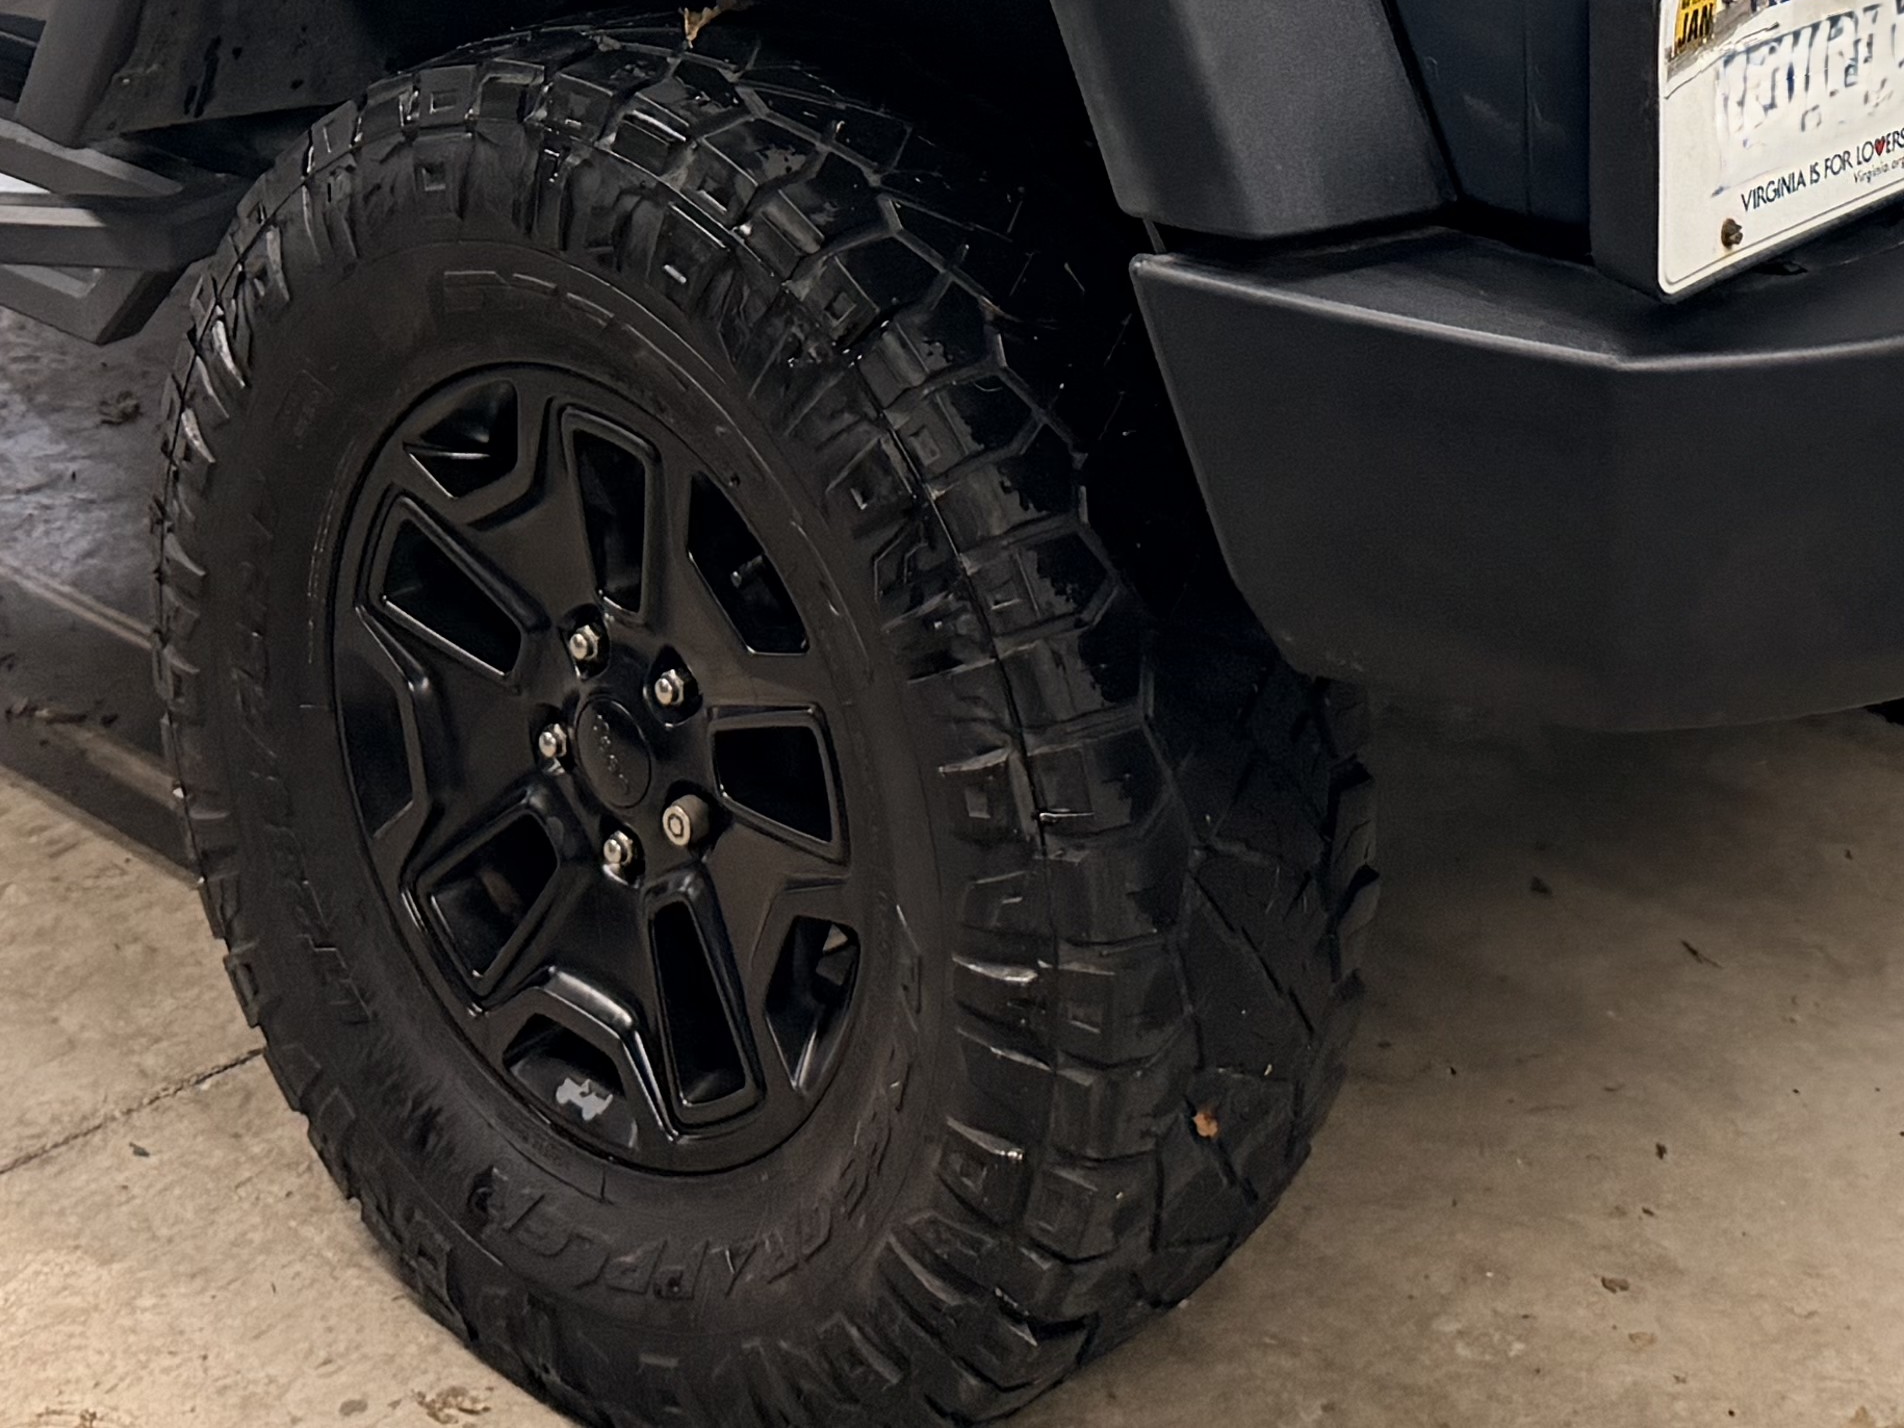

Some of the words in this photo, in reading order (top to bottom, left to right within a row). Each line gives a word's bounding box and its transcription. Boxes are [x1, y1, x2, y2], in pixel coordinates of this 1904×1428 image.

[1677, 3, 1715, 47] JAN
[1741, 169, 1807, 212] VIRGINIA
[1809, 162, 1821, 185] IS
[1824, 150, 1853, 179] FOR
